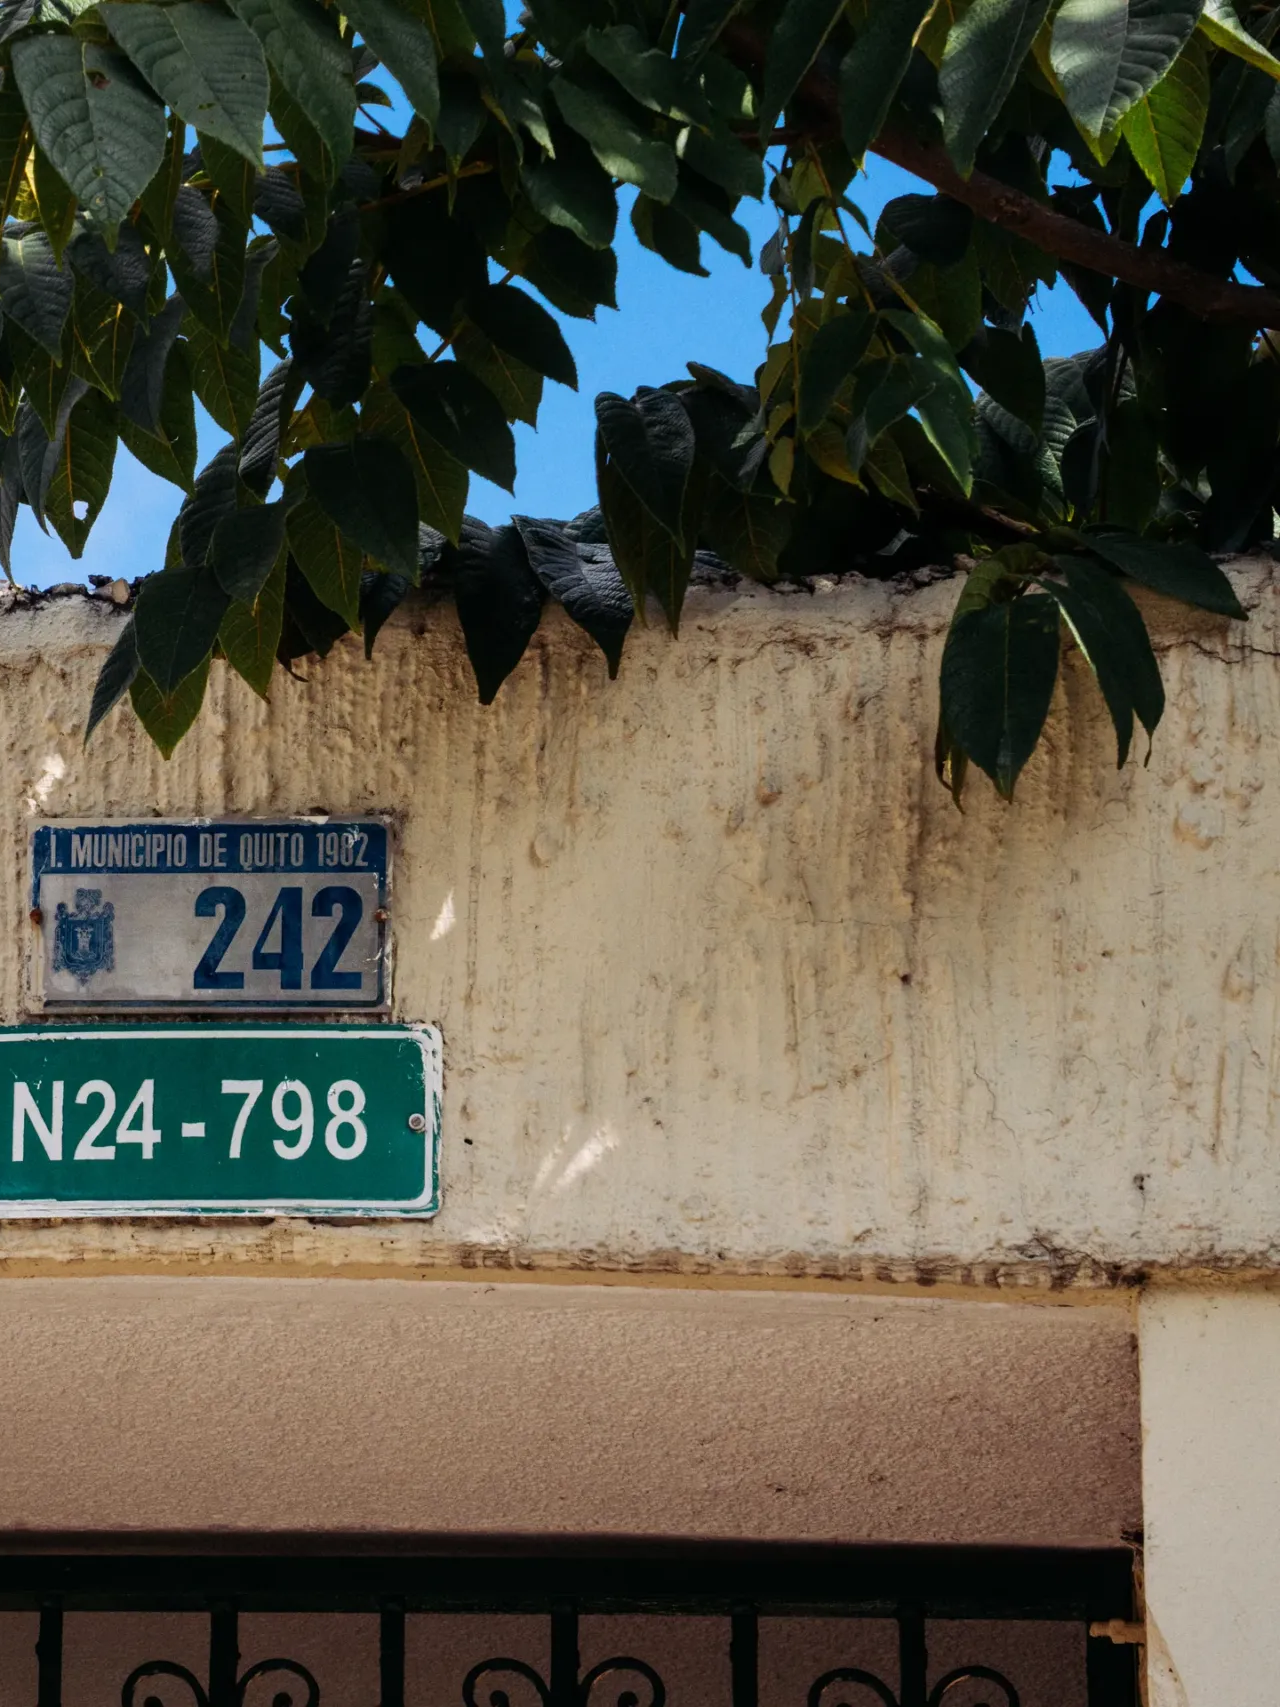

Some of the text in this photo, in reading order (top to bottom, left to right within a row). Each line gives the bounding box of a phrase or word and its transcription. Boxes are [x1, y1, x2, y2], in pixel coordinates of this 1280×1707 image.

[49, 832, 369, 872] I. MUNICIPIO DE QUITO 1982
[193, 885, 364, 990] 242
